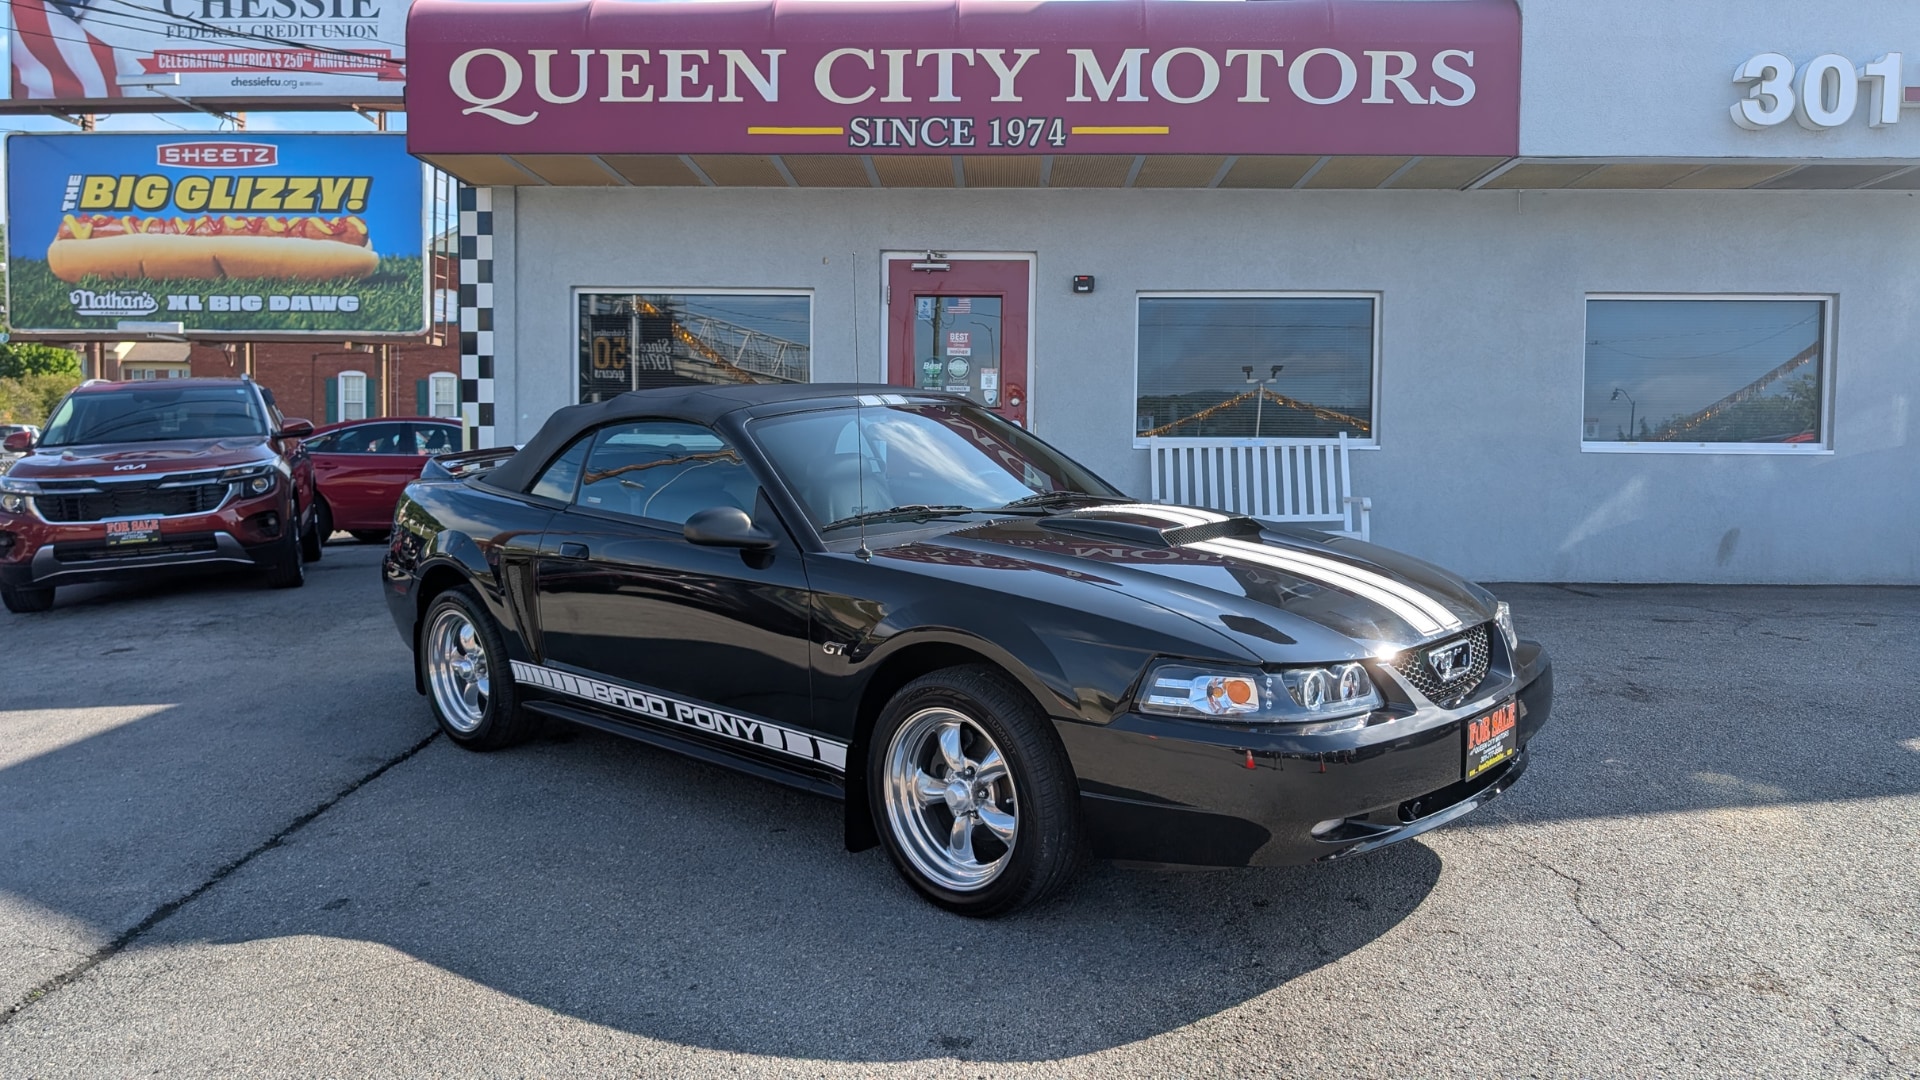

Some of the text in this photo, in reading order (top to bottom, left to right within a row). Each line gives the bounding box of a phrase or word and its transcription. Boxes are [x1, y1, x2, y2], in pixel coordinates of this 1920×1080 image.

[166, 24, 378, 38] FEDERAL CREDIT UNION
[159, 53, 225, 68] CELEBRATING
[228, 53, 281, 68] AMERICA'S
[231, 76, 298, 90] chessiefcu.org
[449, 47, 1477, 125] QUEEN CITY MOTORS
[1729, 52, 1902, 130] 301
[848, 117, 1067, 148] SINCE 1974
[165, 147, 269, 163] SHEETZ
[61, 175, 82, 211] THE
[79, 176, 372, 211] BIG GLIZZY!
[167, 296, 359, 312] XL BIG DAWG
[950, 333, 969, 341] BEST
[923, 362, 943, 370] Best
[107, 522, 130, 534] FOR
[131, 519, 159, 531] SALE
[823, 641, 848, 655] GT
[591, 684, 758, 741] BADD PONY
[1469, 717, 1490, 750] FOR
[1491, 702, 1515, 737] SALE
[986, 714, 1017, 755] SUMMIT
